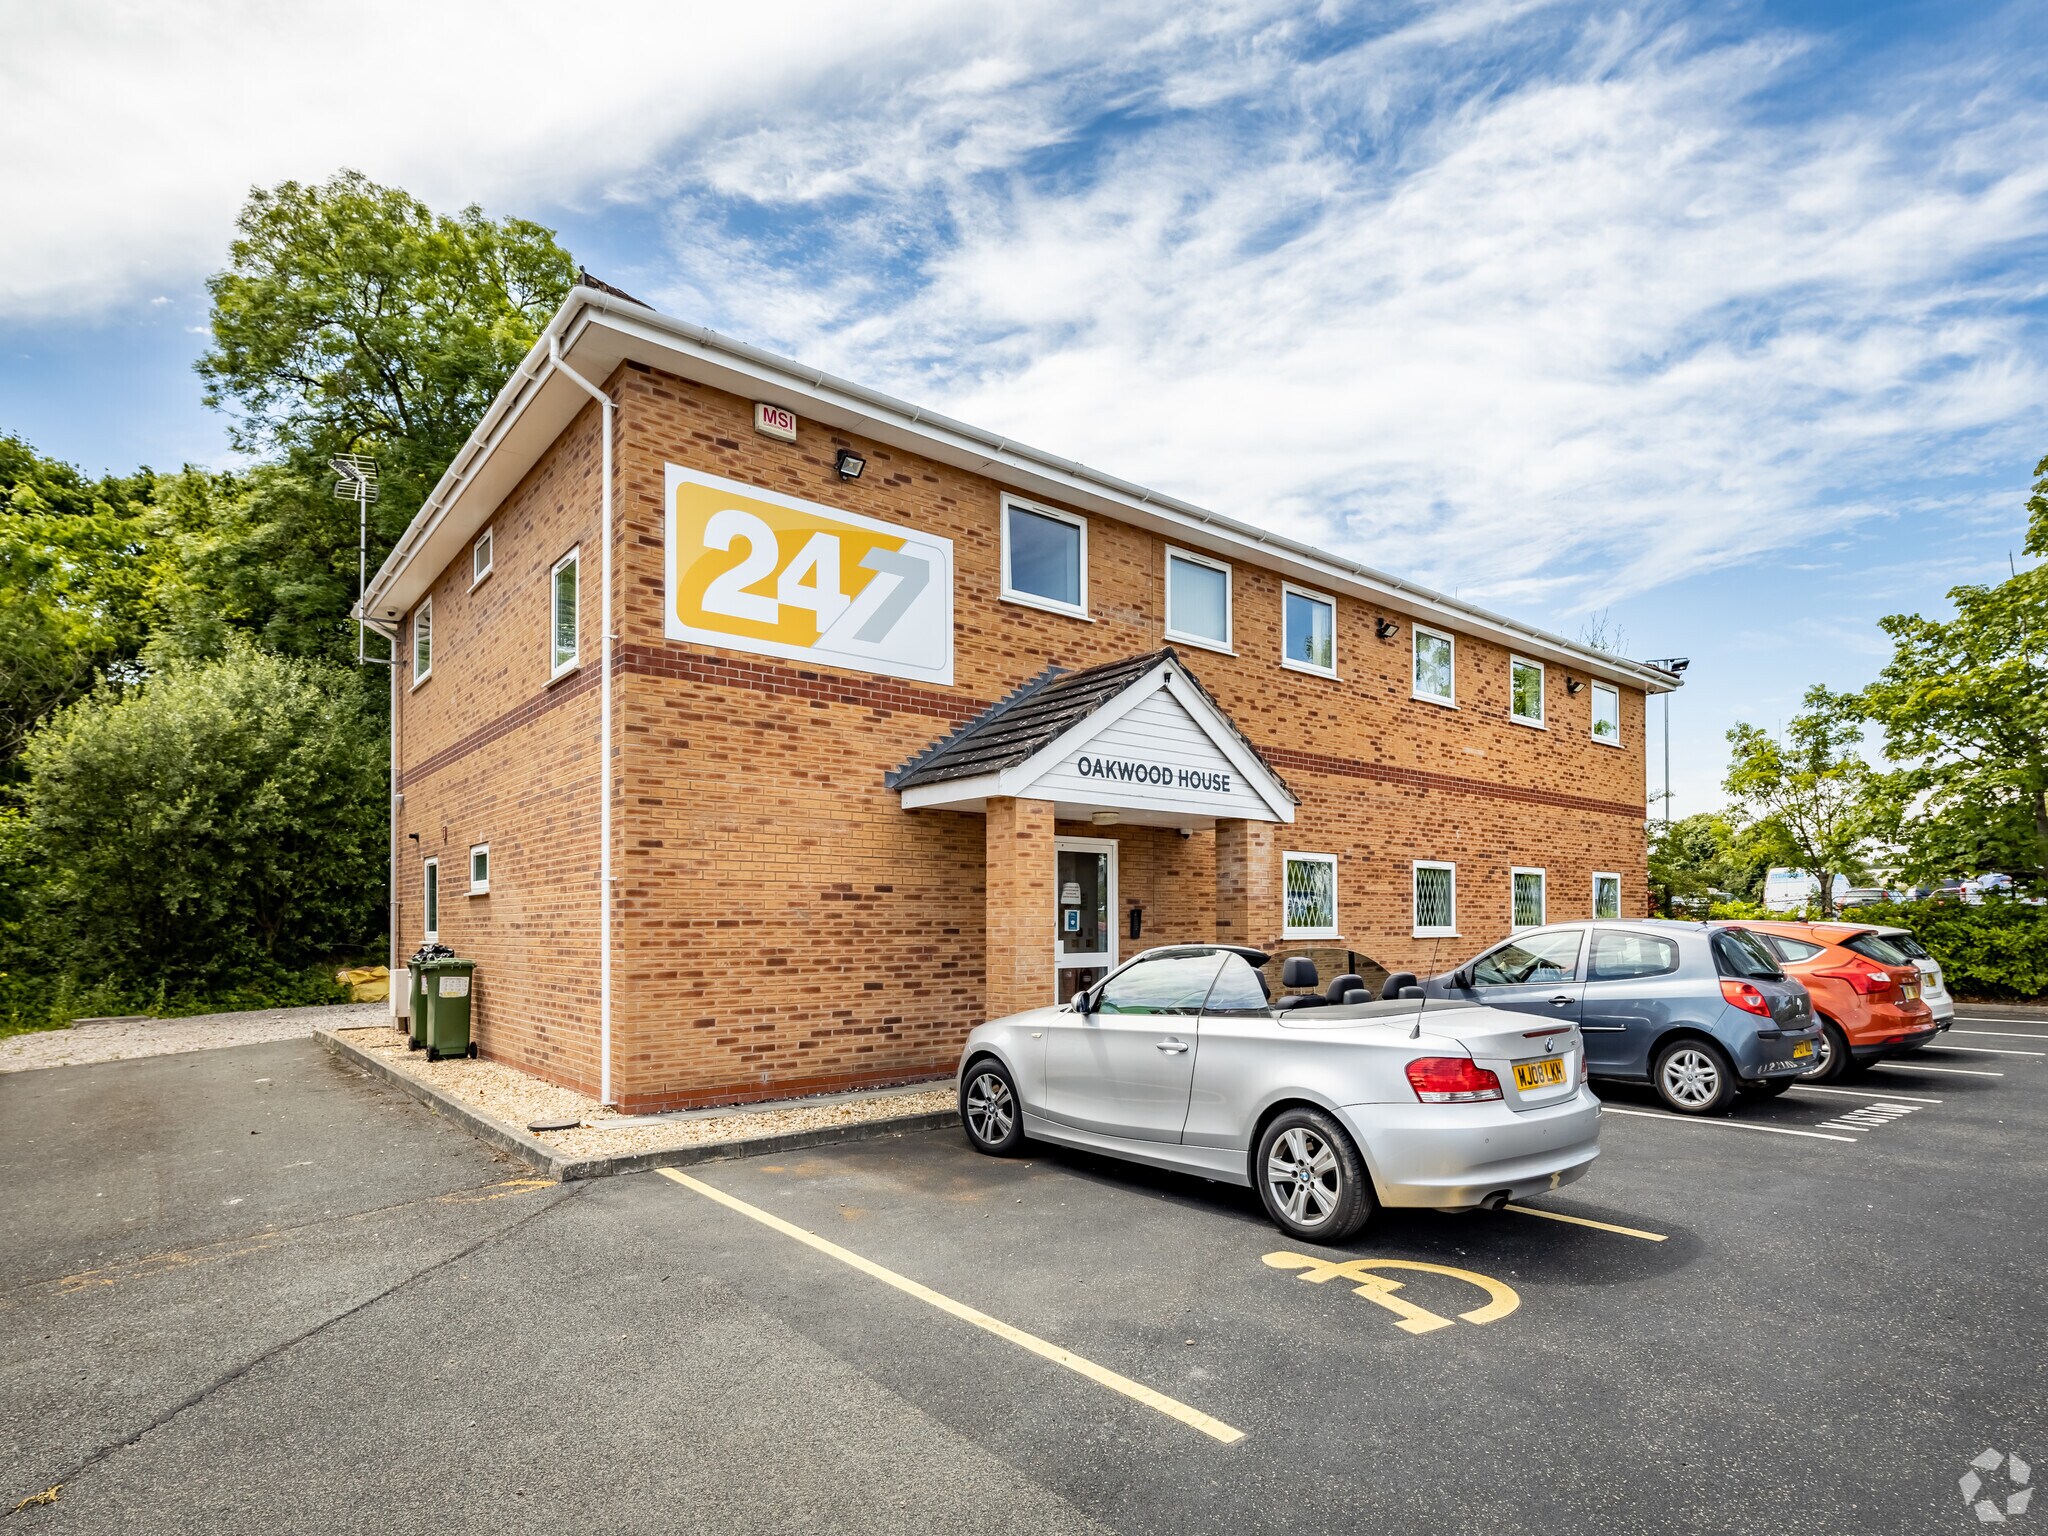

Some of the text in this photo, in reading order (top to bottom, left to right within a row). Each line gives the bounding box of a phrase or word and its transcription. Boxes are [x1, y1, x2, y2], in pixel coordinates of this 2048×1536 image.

[763, 406, 793, 431] MSI
[701, 509, 930, 644] 247
[1078, 756, 1231, 792] OAKWOOD HOUSE
